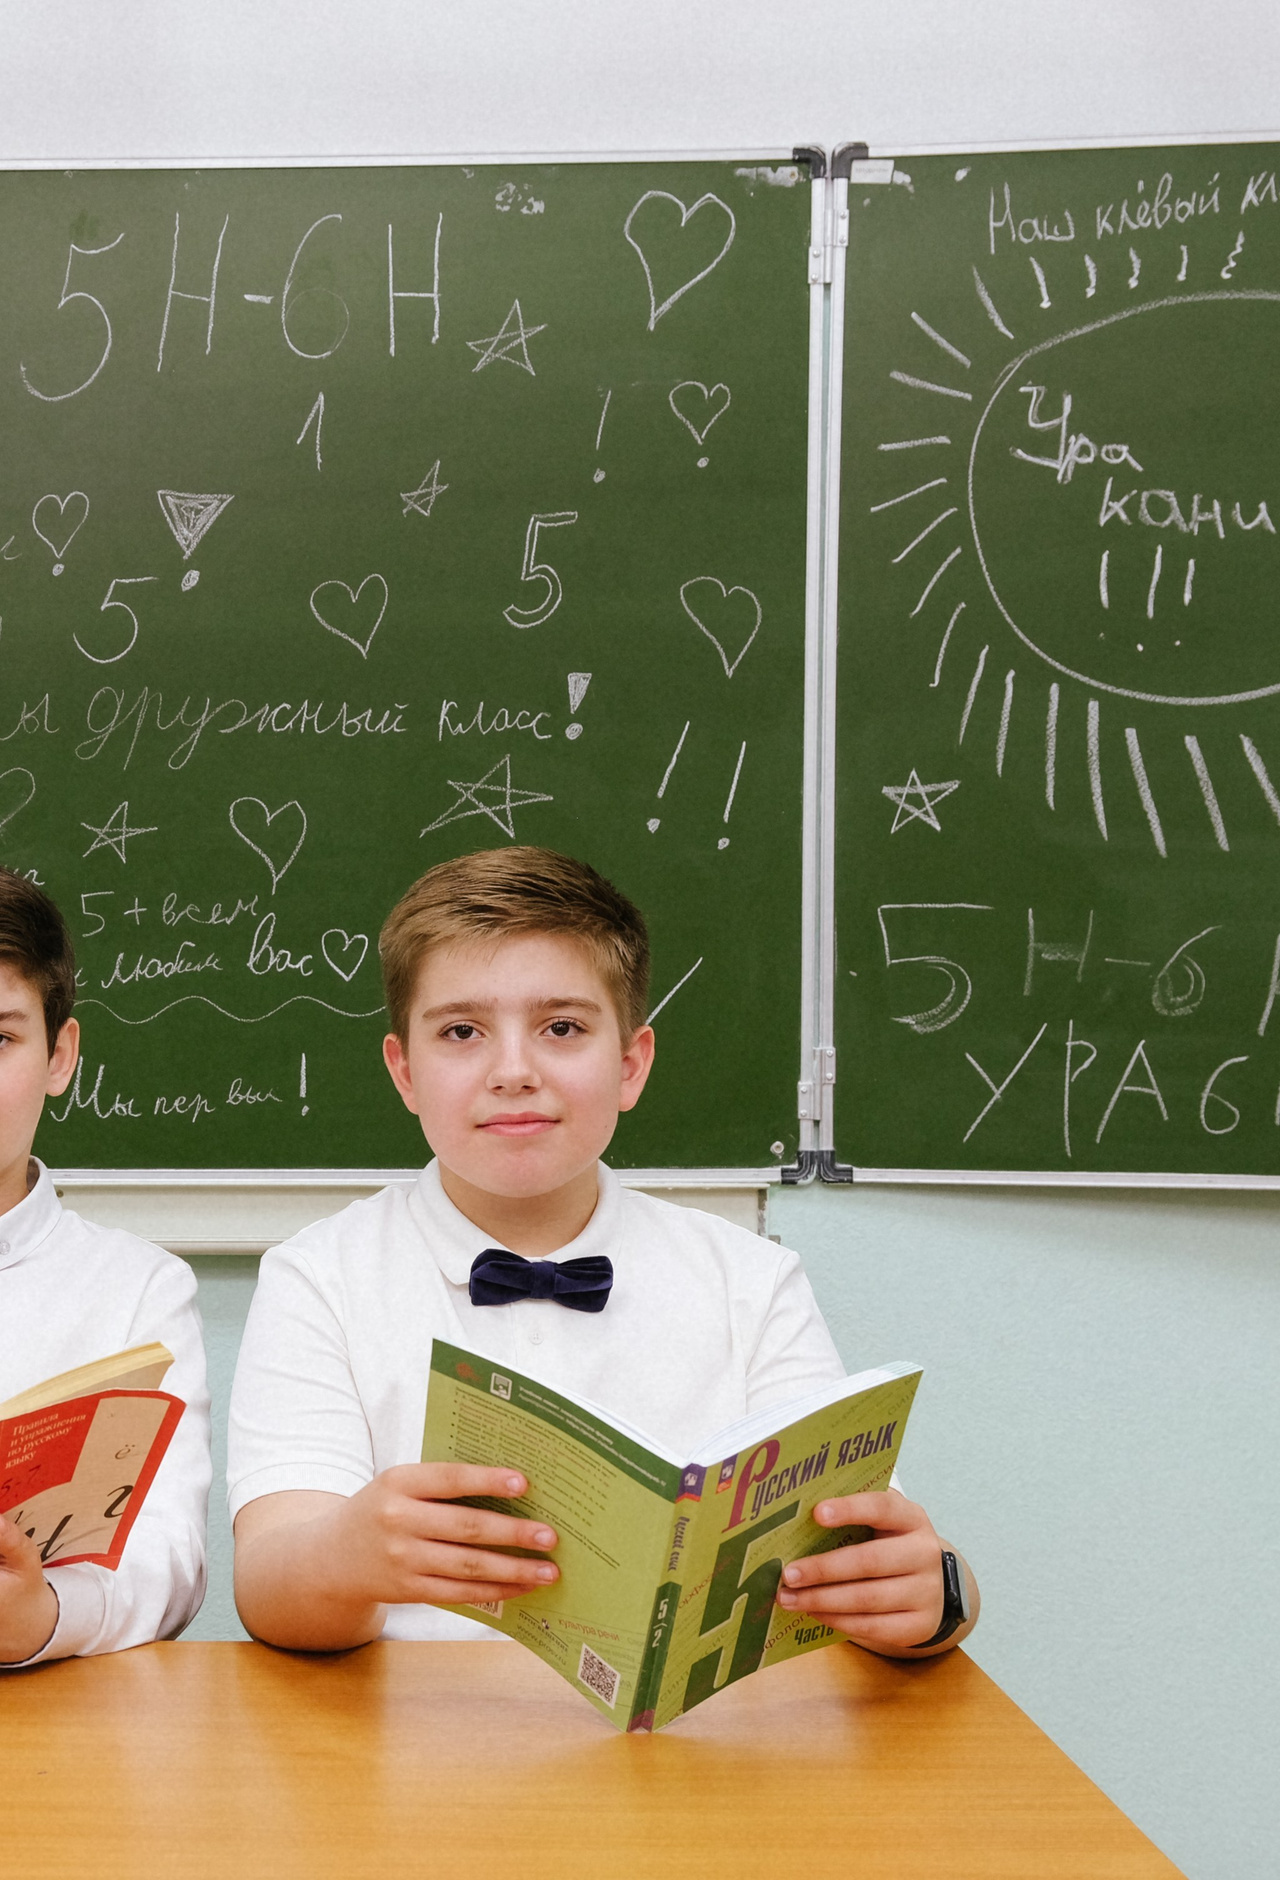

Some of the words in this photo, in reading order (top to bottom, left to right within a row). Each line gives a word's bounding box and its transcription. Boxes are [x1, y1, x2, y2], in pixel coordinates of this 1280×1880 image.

[502, 510, 580, 630] 5
[72, 576, 158, 665] 5
[13, 1413, 59, 1436] Правила
[22, 1426, 73, 1453] русскому
[5, 1450, 38, 1470] языку
[721, 1438, 831, 1534] Русский
